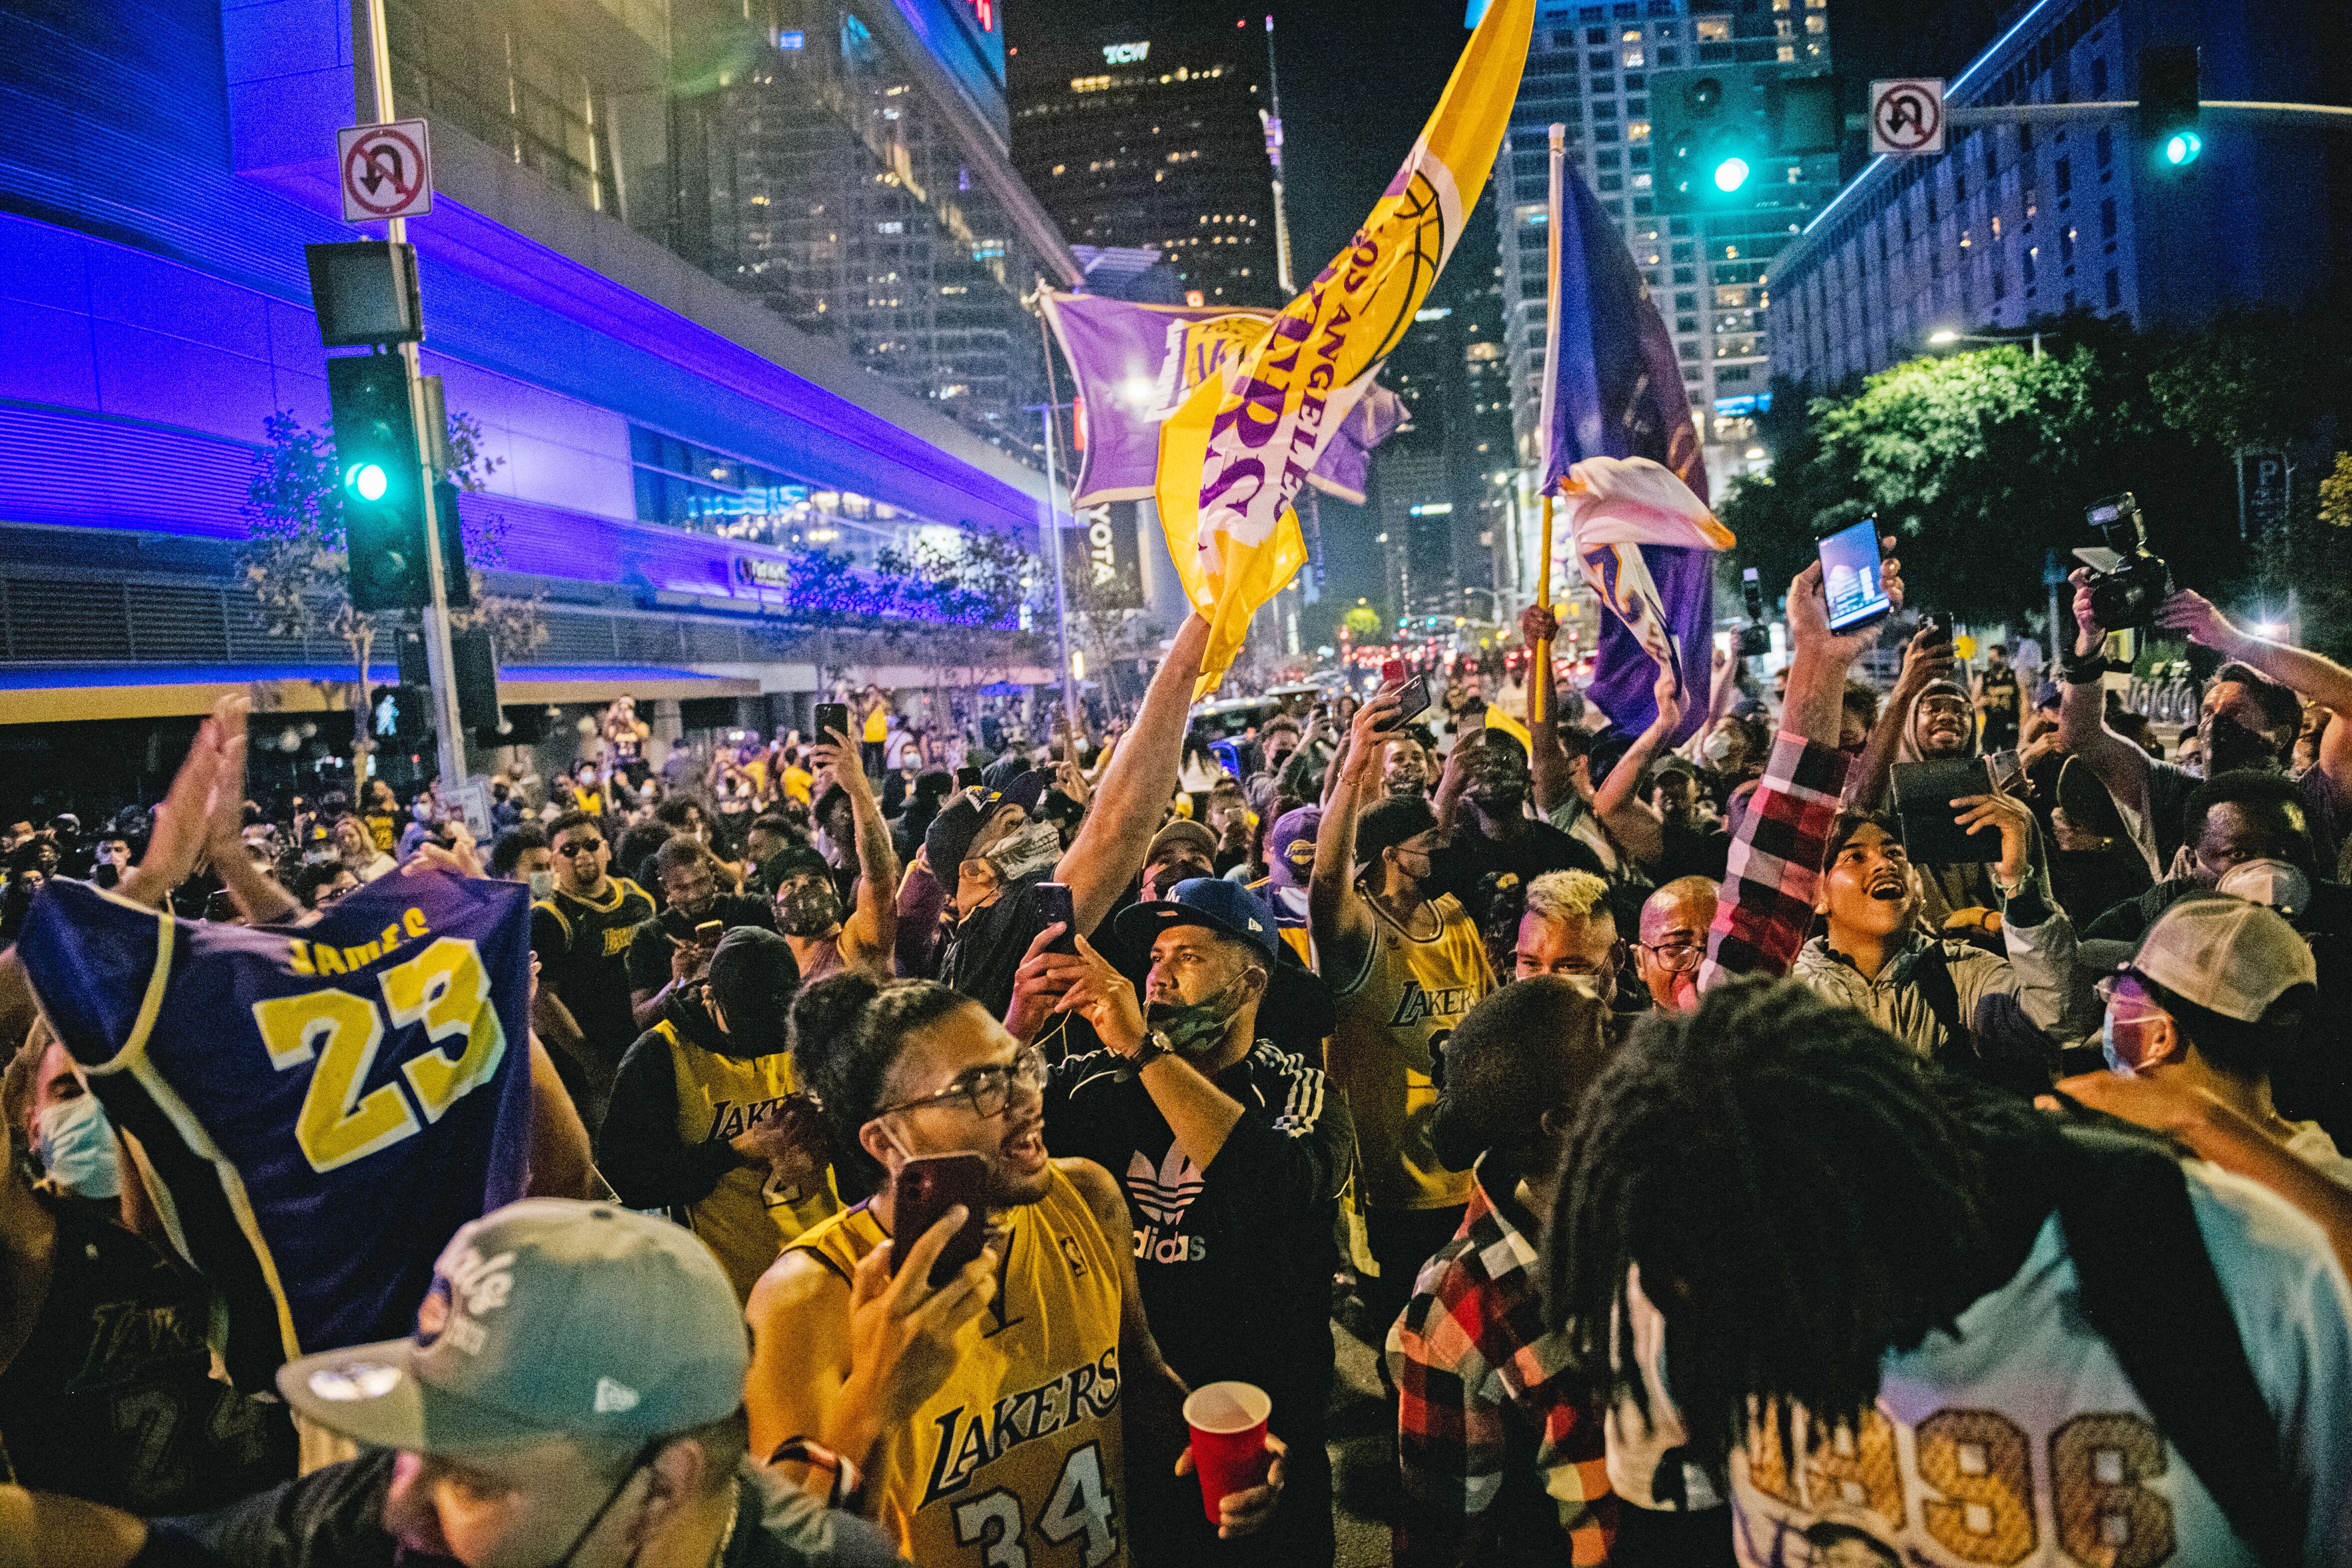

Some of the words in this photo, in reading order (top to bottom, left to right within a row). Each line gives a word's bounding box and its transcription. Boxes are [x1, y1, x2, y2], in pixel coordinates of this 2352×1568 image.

[1103, 41, 1150, 65] TCW
[1089, 503, 1115, 585] YOTA
[1386, 981, 1476, 1027] LAKER
[252, 937, 507, 1173] 23
[1133, 1225, 1206, 1264] didas
[918, 1348, 1121, 1512] LAKERS
[952, 1440, 1121, 1568] 34
